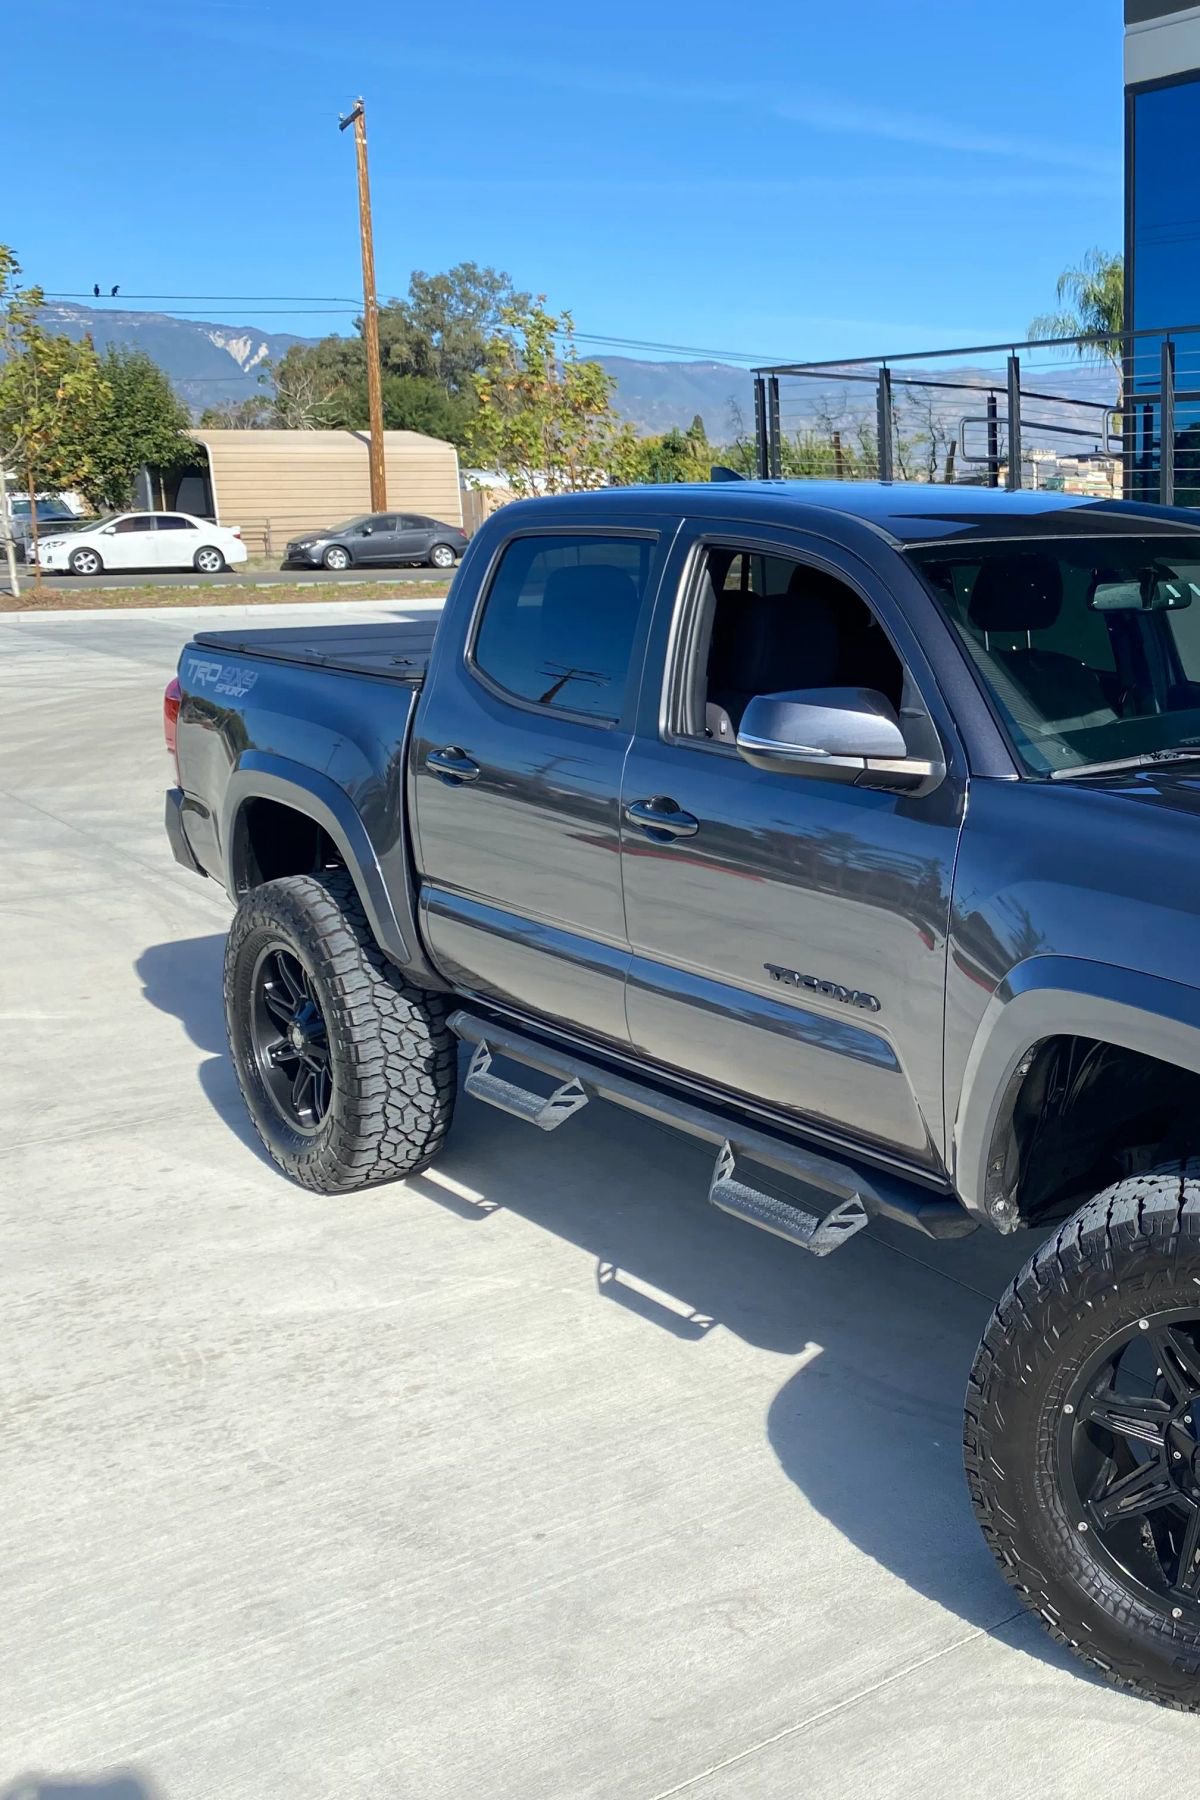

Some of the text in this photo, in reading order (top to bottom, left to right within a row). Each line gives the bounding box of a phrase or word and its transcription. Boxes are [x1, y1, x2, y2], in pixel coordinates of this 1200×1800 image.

[187, 659, 222, 687] TRD
[214, 683, 248, 698] SPORT
[763, 962, 882, 1012] TACOMA
